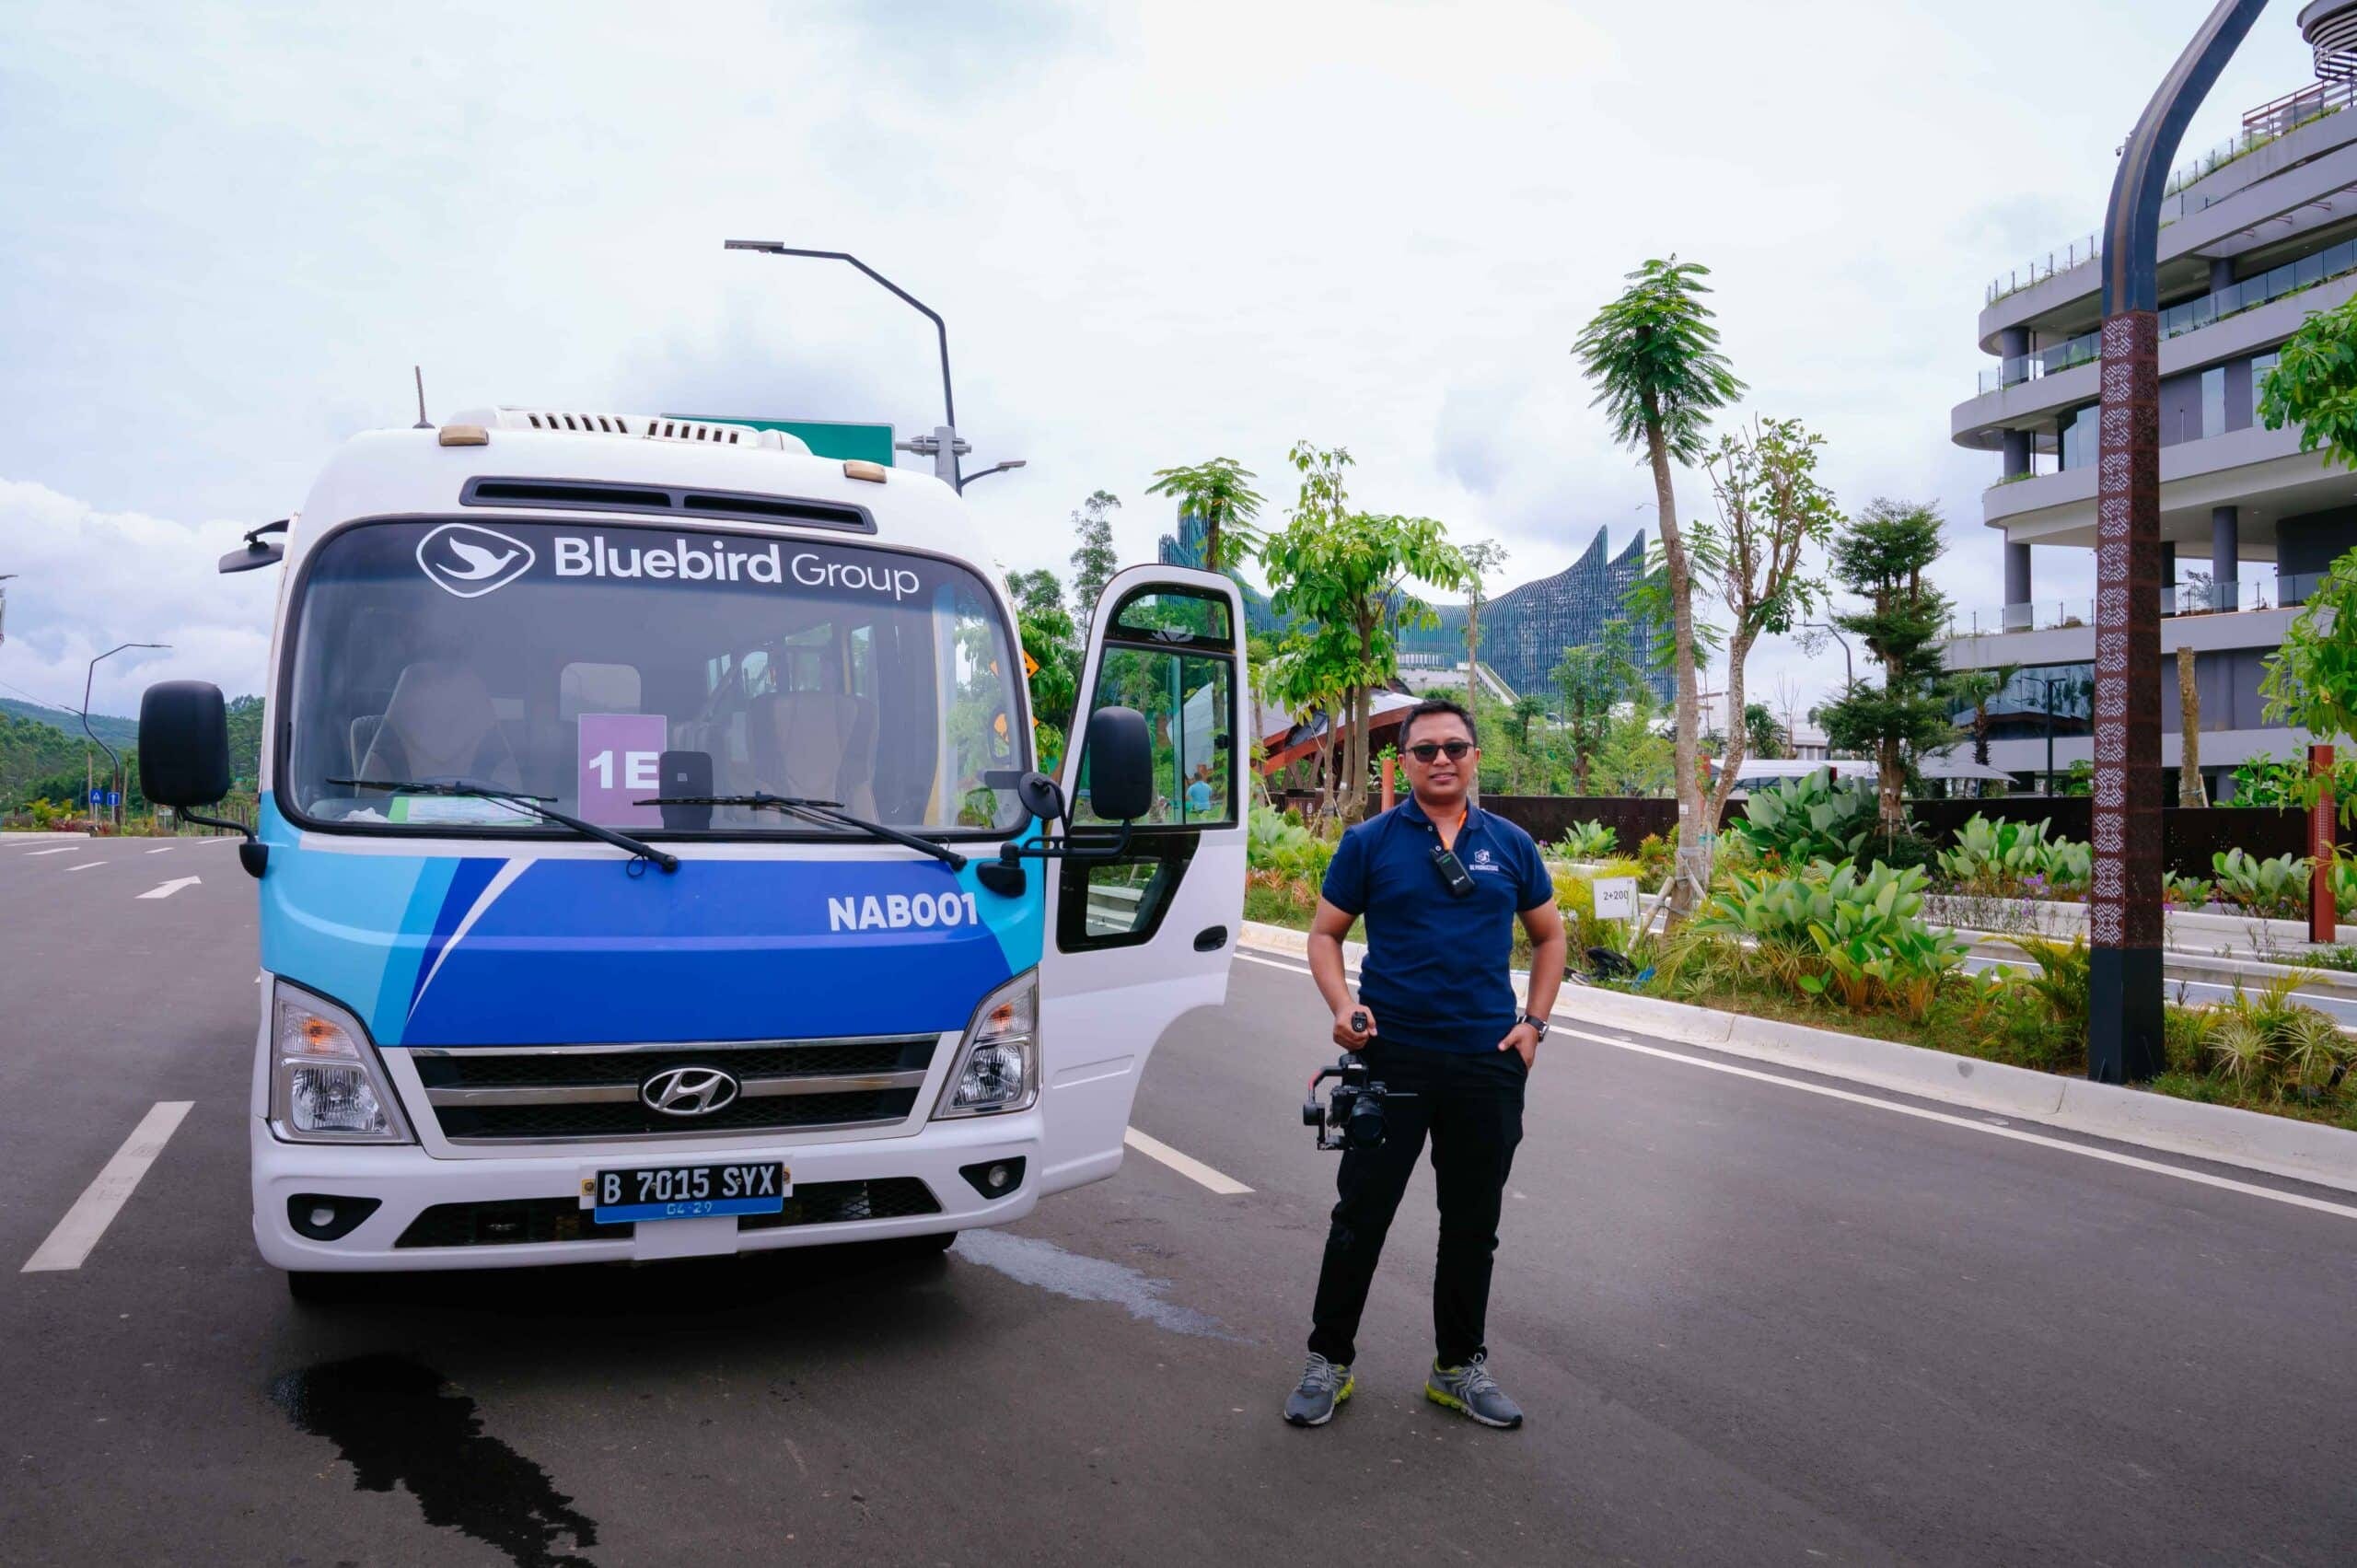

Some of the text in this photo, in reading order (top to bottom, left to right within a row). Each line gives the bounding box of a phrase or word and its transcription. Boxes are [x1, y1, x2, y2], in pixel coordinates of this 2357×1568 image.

[554, 538, 919, 600] Bluebird Group
[589, 750, 659, 789] 1E
[828, 891, 978, 931] NAB001
[604, 1166, 775, 1203] B 7015 SYX
